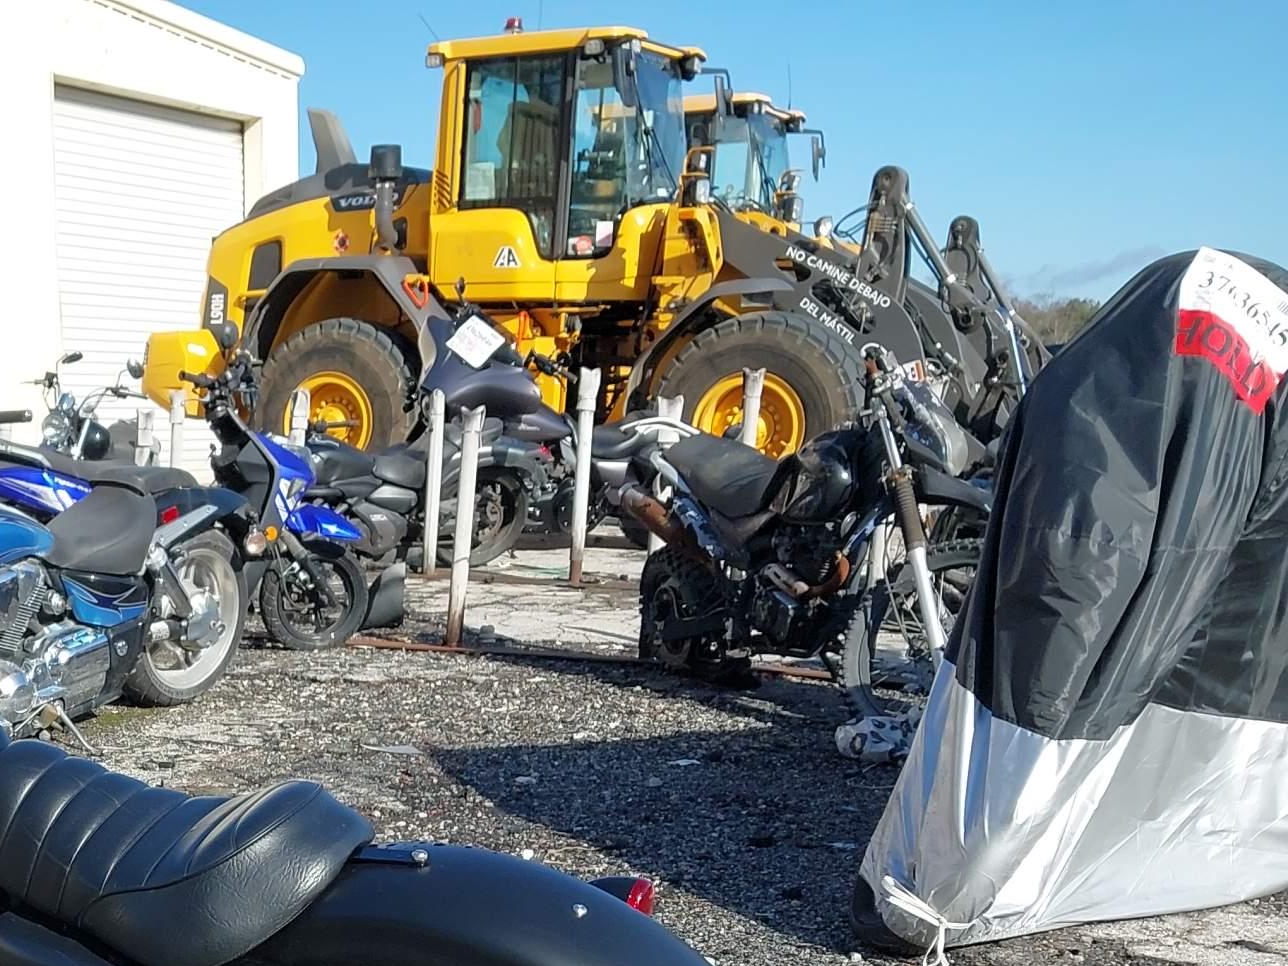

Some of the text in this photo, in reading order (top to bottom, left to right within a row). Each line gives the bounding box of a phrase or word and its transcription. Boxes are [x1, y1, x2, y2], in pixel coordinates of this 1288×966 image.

[786, 247, 891, 308] NO CAMINE DEBAJO
[210, 293, 224, 325] L90H
[799, 297, 855, 344] DEL MÁSTIL
